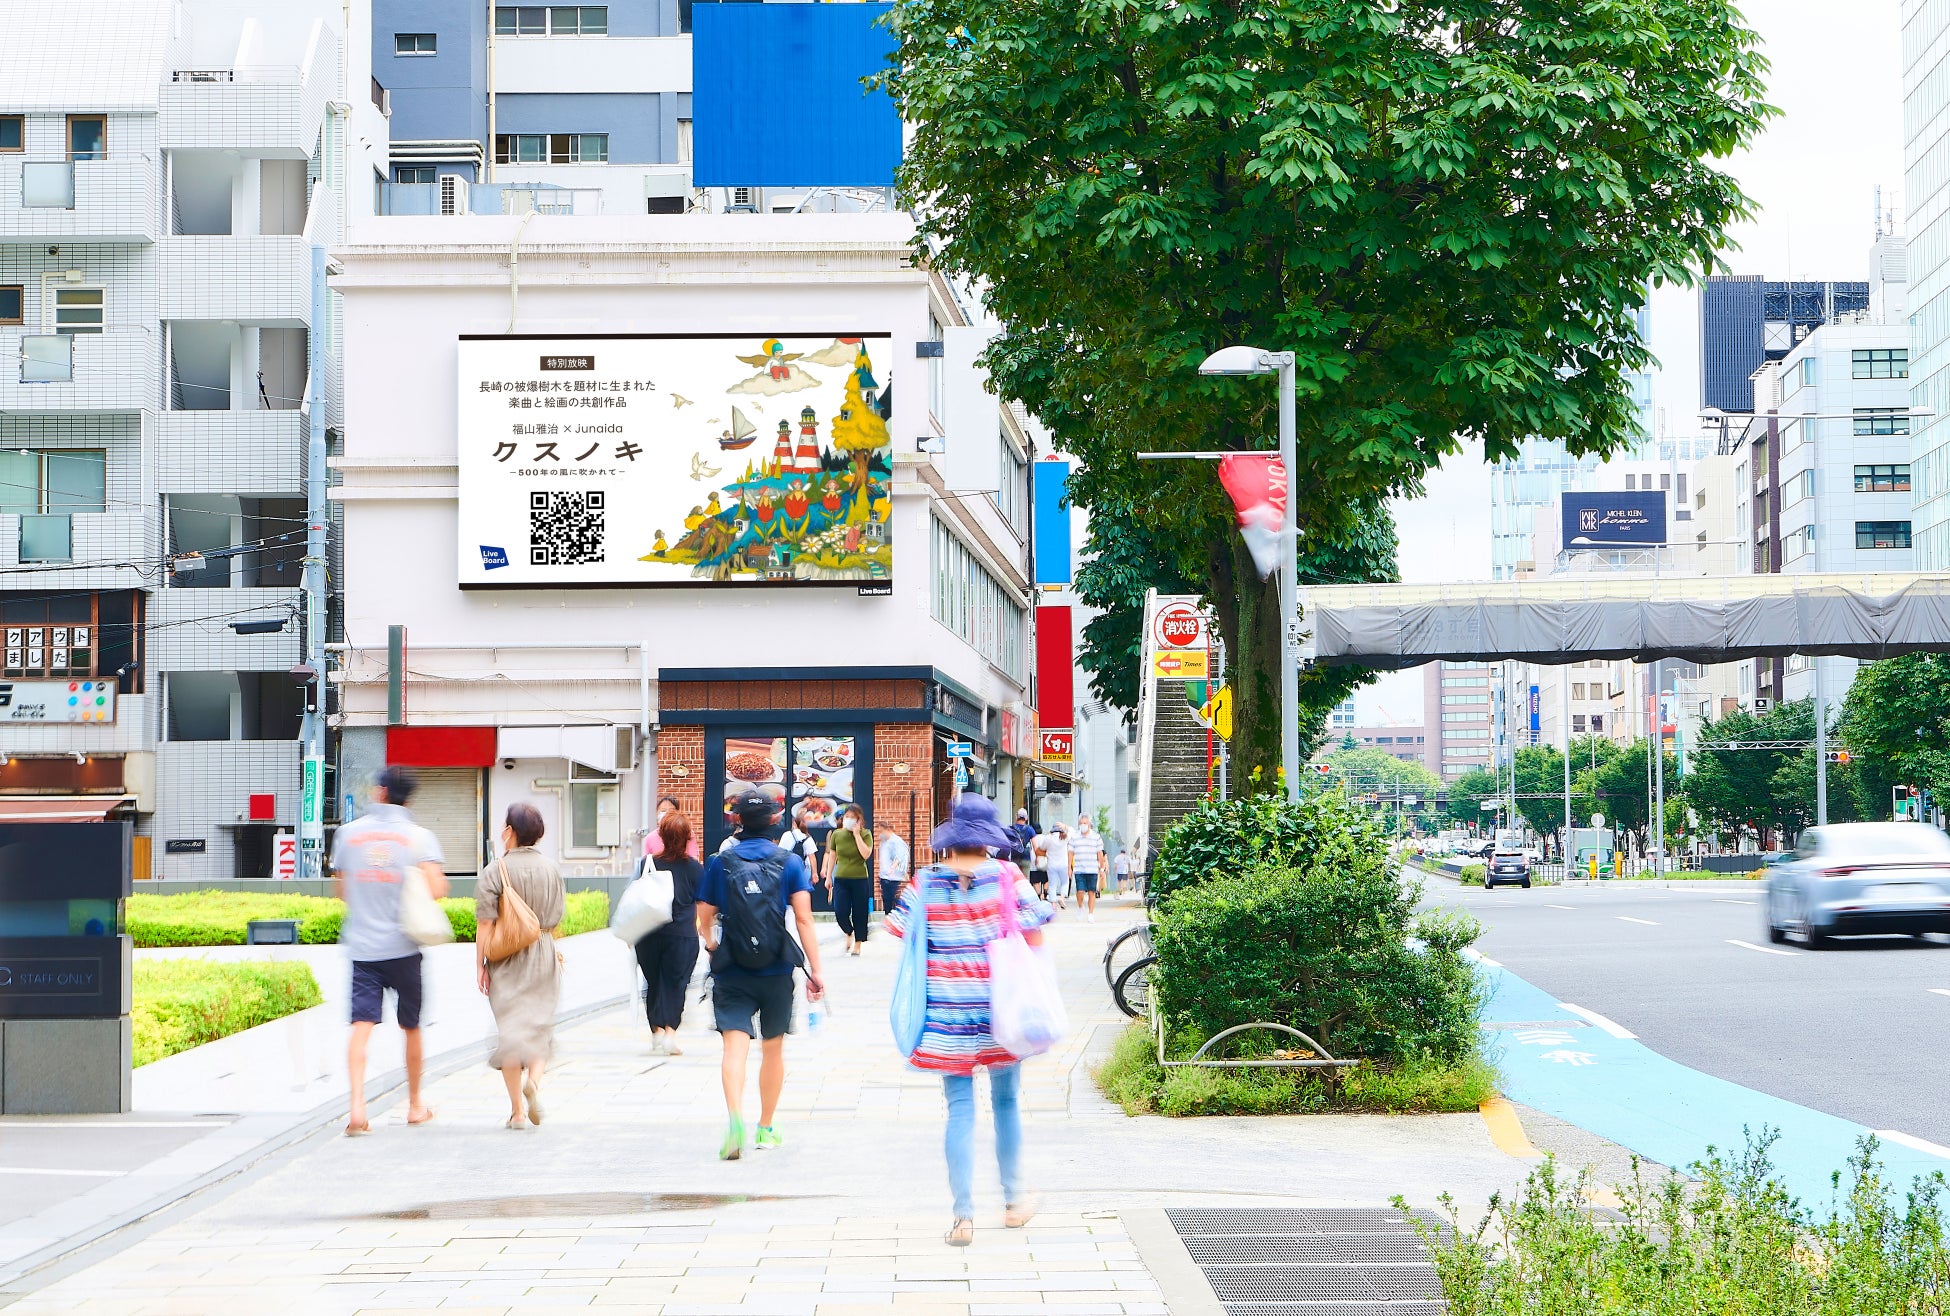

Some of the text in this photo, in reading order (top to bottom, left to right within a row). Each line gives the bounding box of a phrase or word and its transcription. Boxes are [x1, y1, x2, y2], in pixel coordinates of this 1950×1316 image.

[547, 358, 588, 368] 特別放映
[479, 380, 656, 392] 長崎の被爆樹木を題材に生まれた
[508, 396, 627, 408] 楽曲と絵画の共創作品
[512, 424, 559, 434] 福山雅治
[492, 441, 643, 462] クスノキ
[1165, 620, 1196, 635] 消火栓
[10, 631, 86, 643] クアウト
[10, 652, 66, 664] ました
[1044, 734, 1070, 754] くすり
[306, 772, 314, 798] GREEN
[20, 974, 52, 984] STAFF
[57, 974, 93, 986] ONLY
